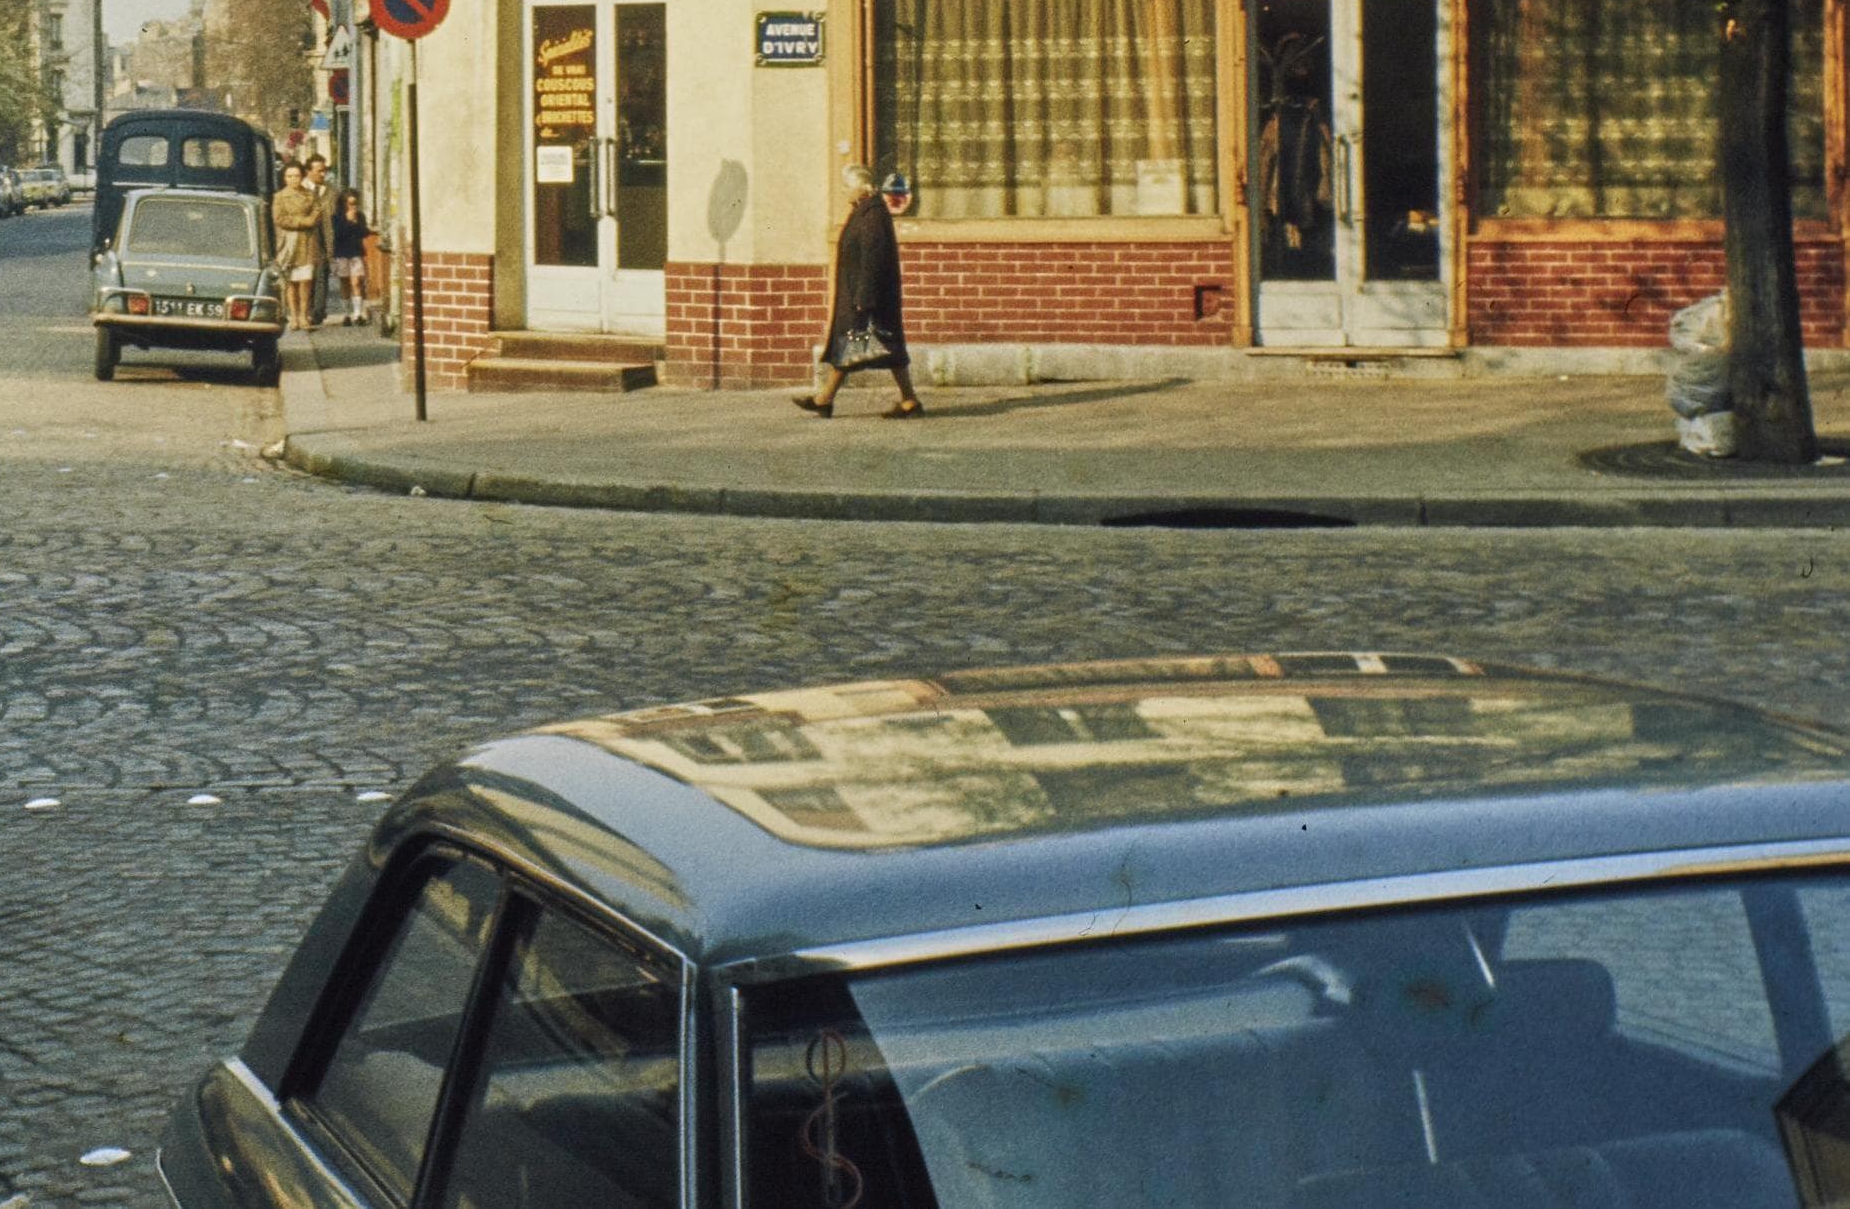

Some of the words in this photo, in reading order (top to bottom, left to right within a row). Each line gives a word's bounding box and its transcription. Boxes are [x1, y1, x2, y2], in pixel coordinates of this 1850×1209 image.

[765, 23, 815, 36] AVENUE
[536, 77, 595, 92] COUSCOUS
[540, 93, 591, 107] ORIENTAL
